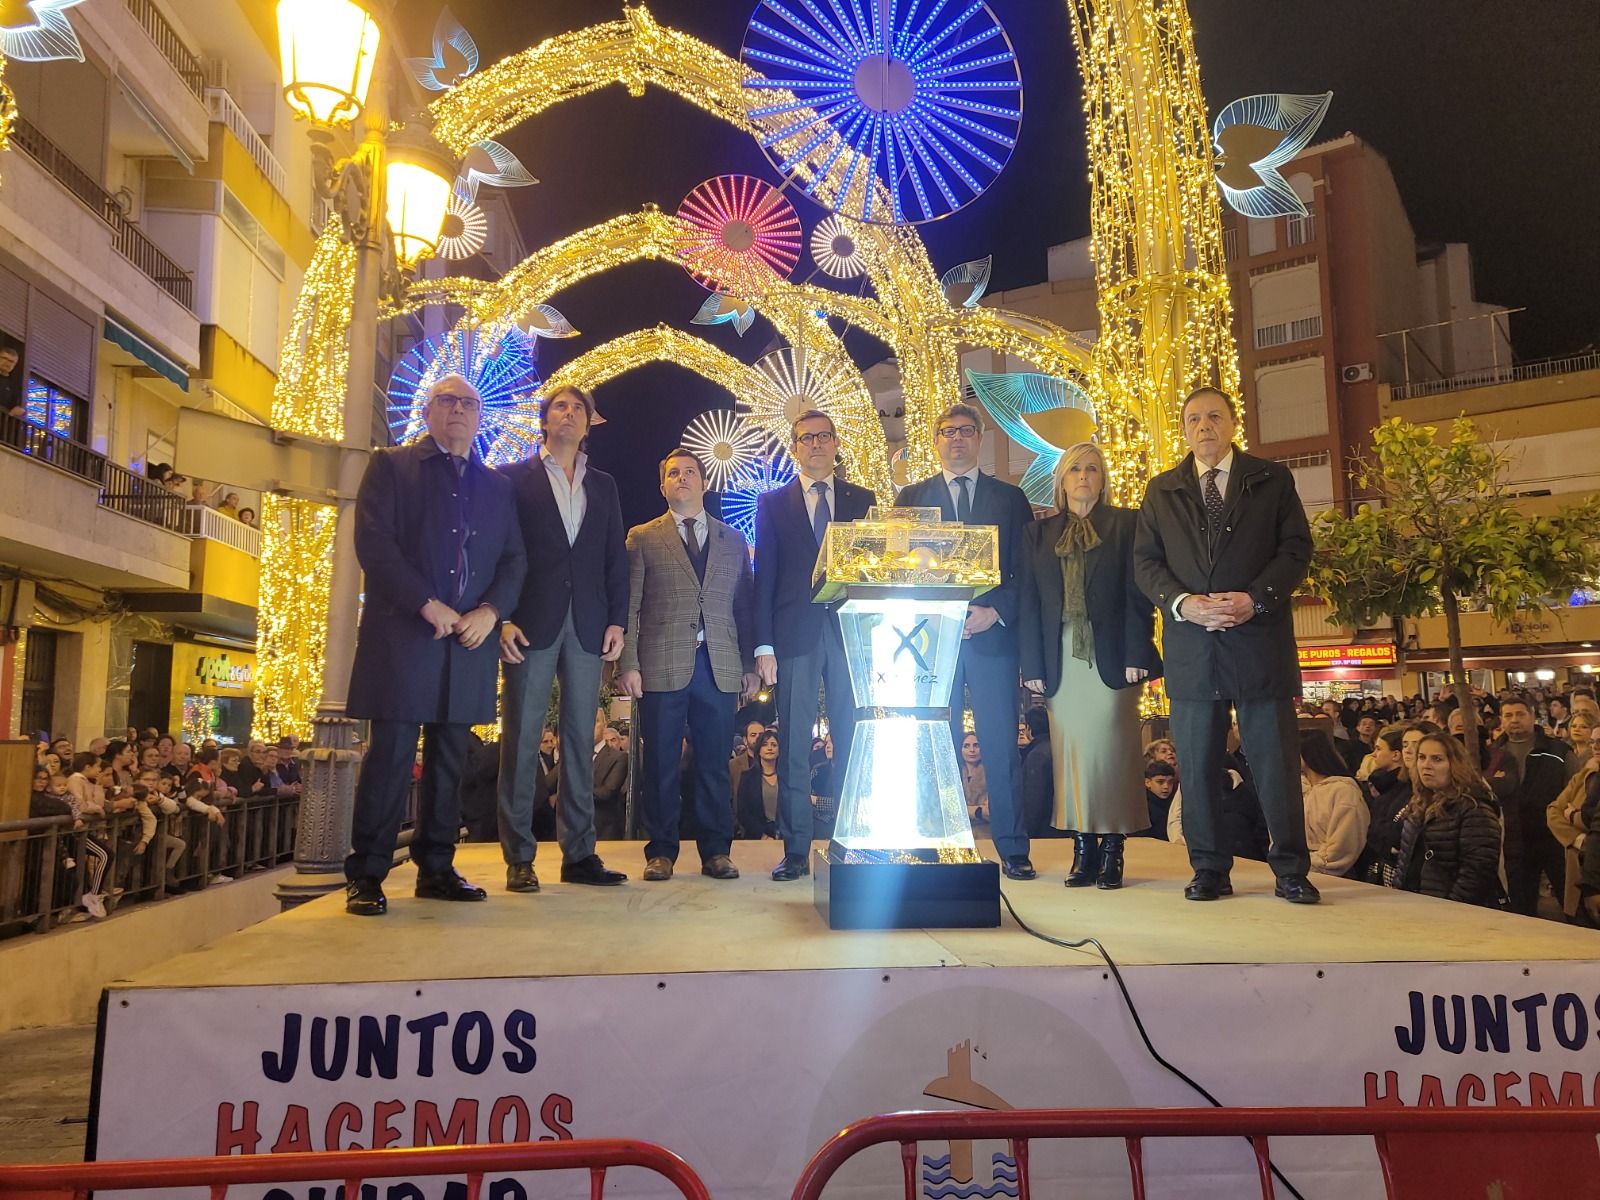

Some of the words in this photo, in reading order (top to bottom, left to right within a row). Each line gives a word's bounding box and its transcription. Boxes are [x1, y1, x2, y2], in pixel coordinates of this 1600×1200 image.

[1310, 648, 1341, 659] PUROS
[1346, 647, 1391, 657] REGALOS
[261, 1008, 537, 1082] JUNTOS
[1394, 990, 1600, 1055] JUNTO
[1364, 1070, 1600, 1107] HACEM
[215, 1093, 573, 1155] HACEMOS
